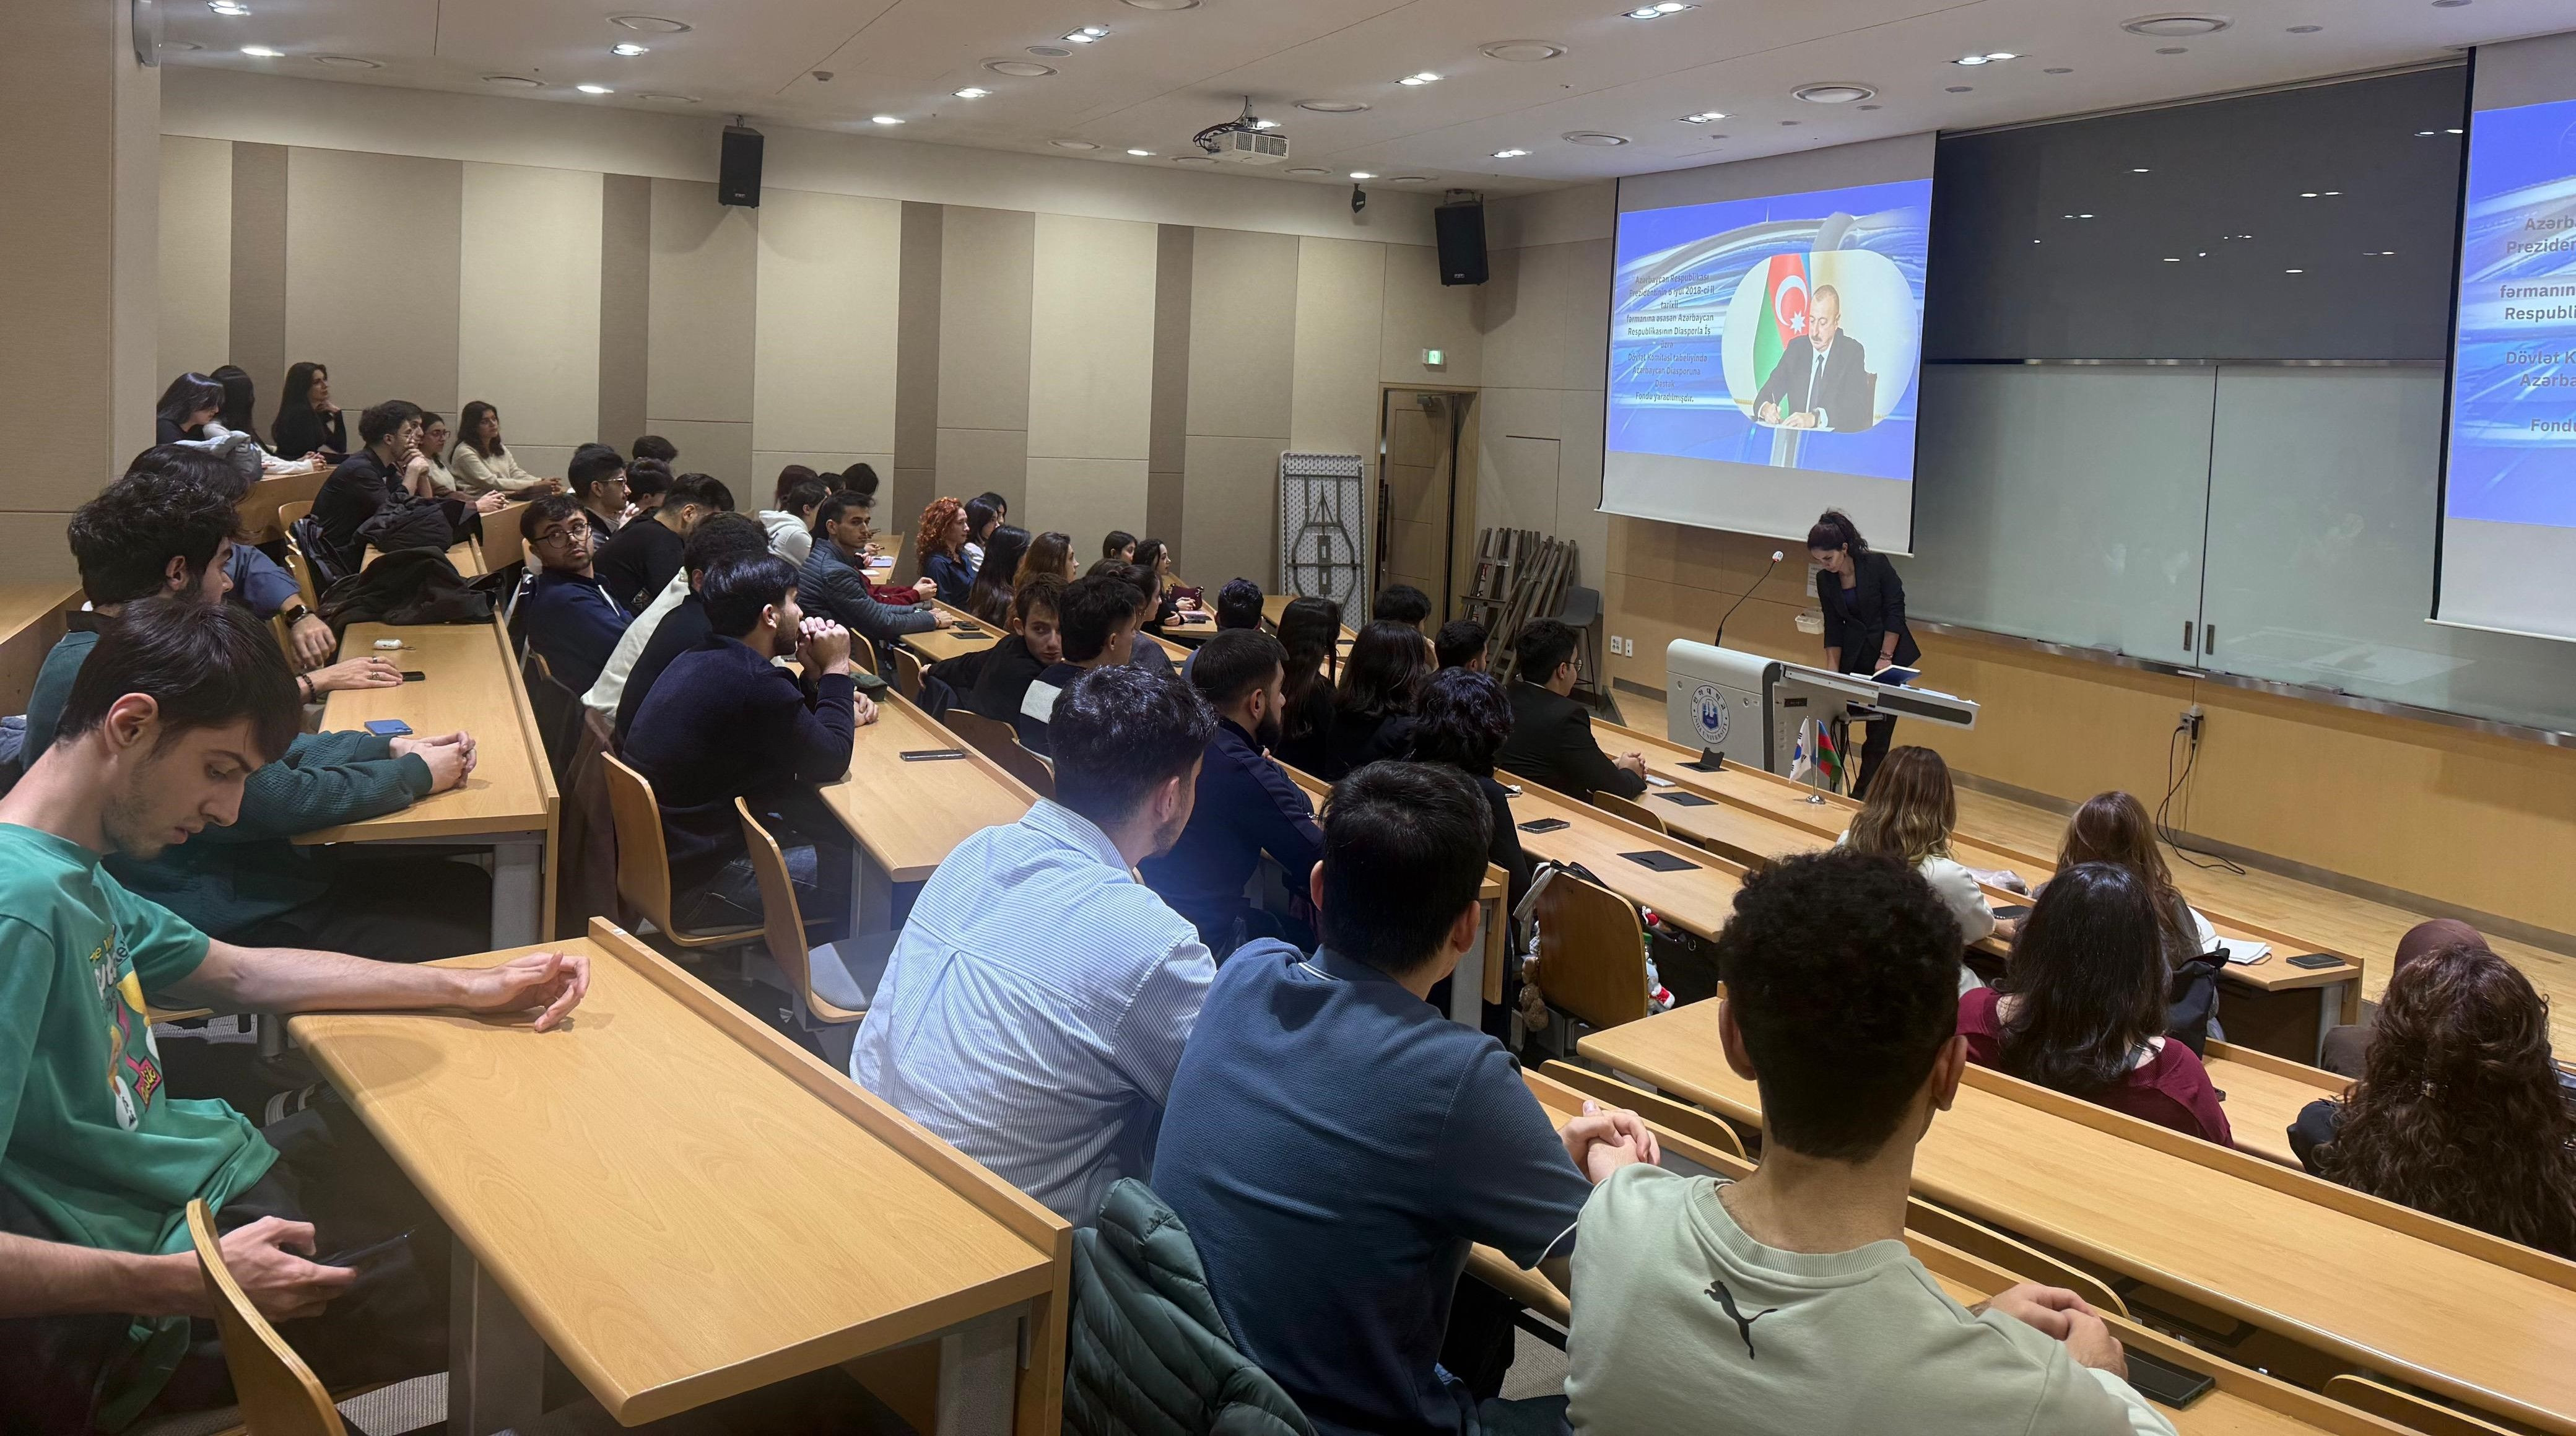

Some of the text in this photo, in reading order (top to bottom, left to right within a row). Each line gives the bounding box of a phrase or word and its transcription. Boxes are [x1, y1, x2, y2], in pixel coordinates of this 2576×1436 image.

[2524, 215, 2576, 230] Azərb
[1686, 285, 1710, 295] 2018-ci
[1661, 300, 1679, 310] tarixli
[1677, 313, 1714, 323] Azərbaycan
[1628, 327, 1673, 336] Respublikasının
[1674, 327, 1703, 336] Diasporla
[2506, 350, 2560, 364] Dövlət
